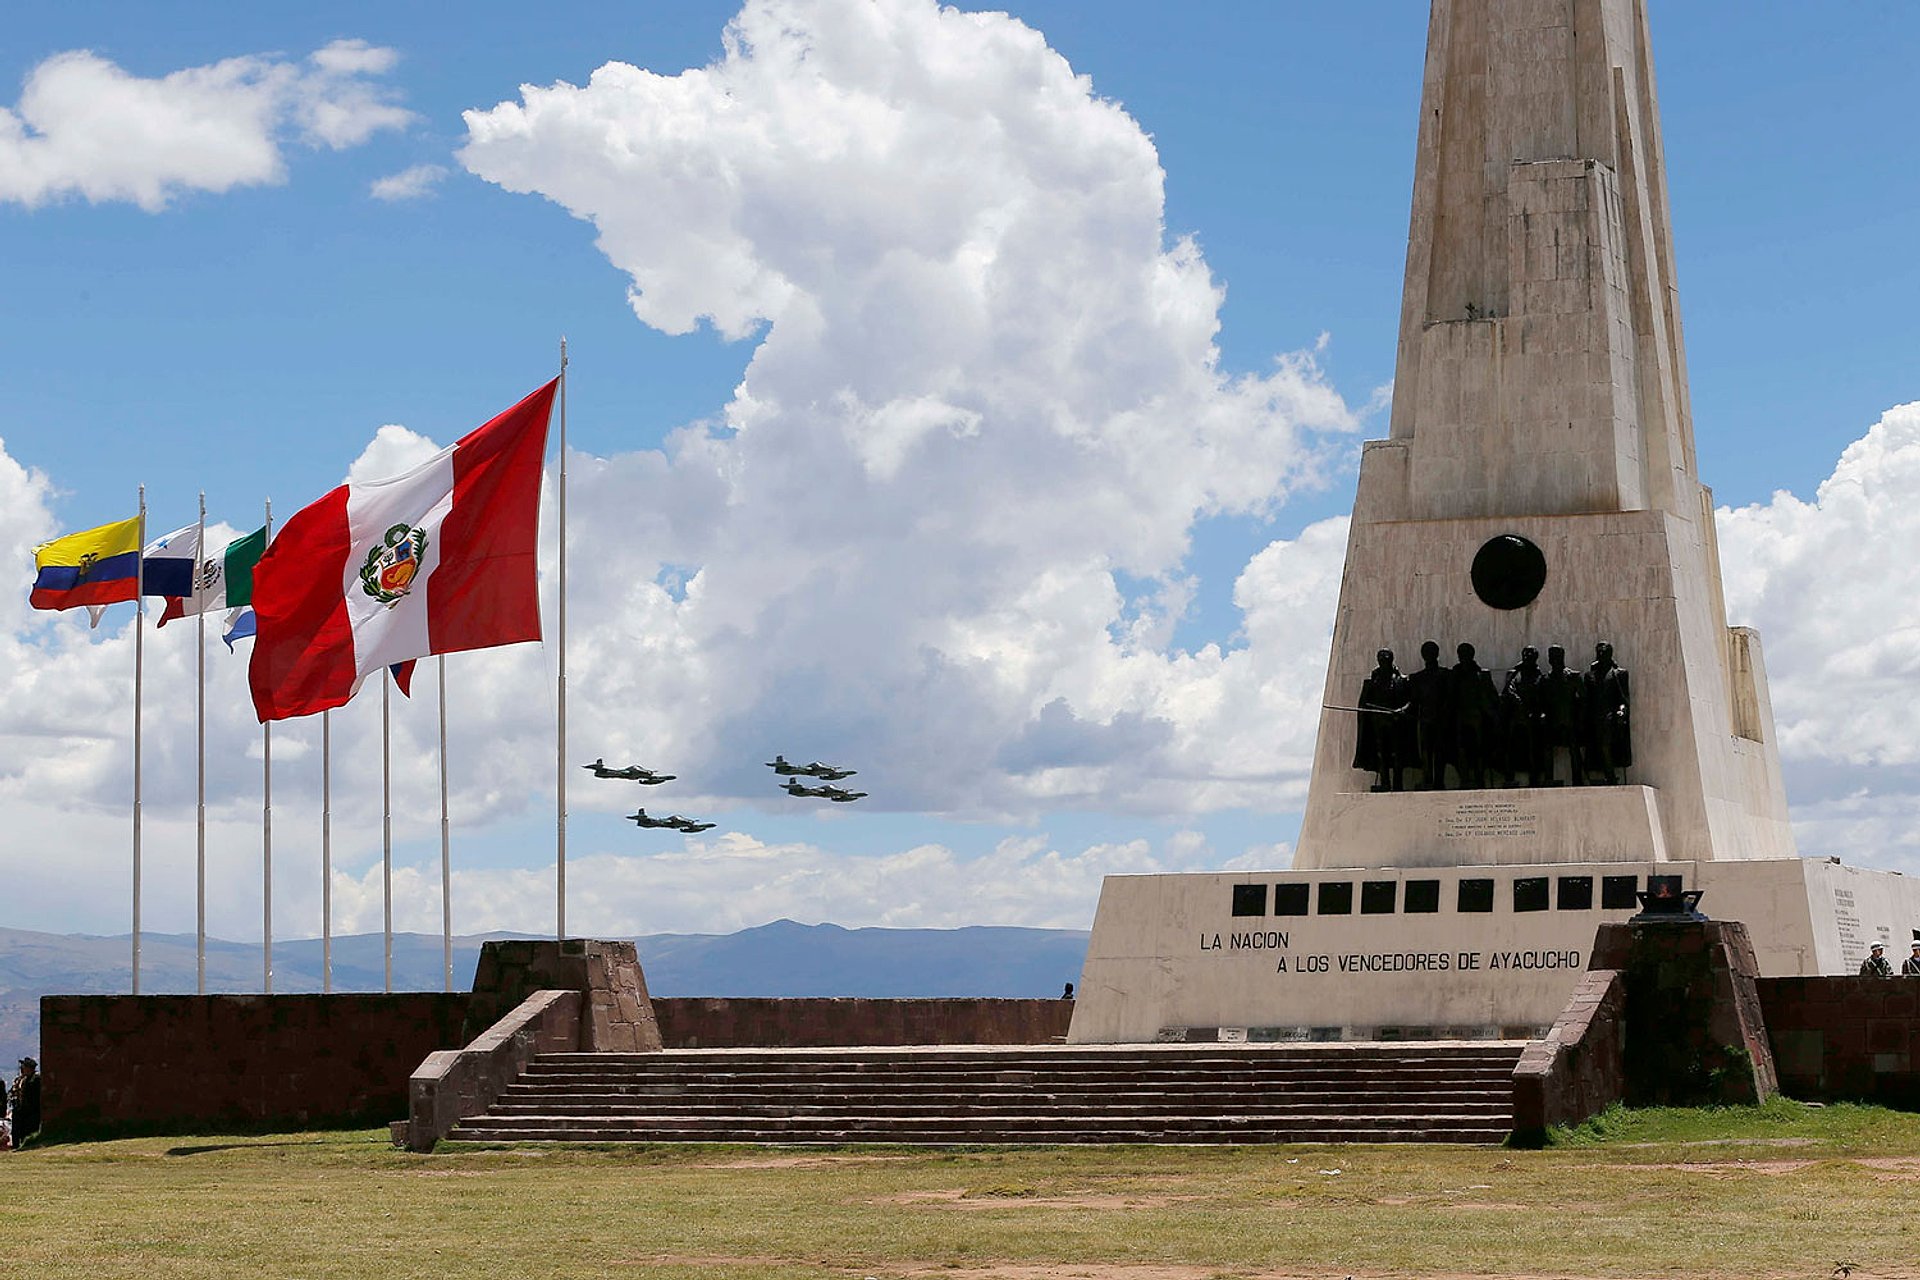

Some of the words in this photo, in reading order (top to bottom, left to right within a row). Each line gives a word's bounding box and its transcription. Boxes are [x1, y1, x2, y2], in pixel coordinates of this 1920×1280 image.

[1200, 932, 1222, 950] LA
[1230, 931, 1289, 950] NACION
[1276, 956, 1288, 974] A
[1295, 955, 1330, 973] LOS
[1337, 953, 1450, 972] VENCEDORES
[1457, 952, 1481, 971] DE
[1489, 950, 1580, 970] AYACUCHO
